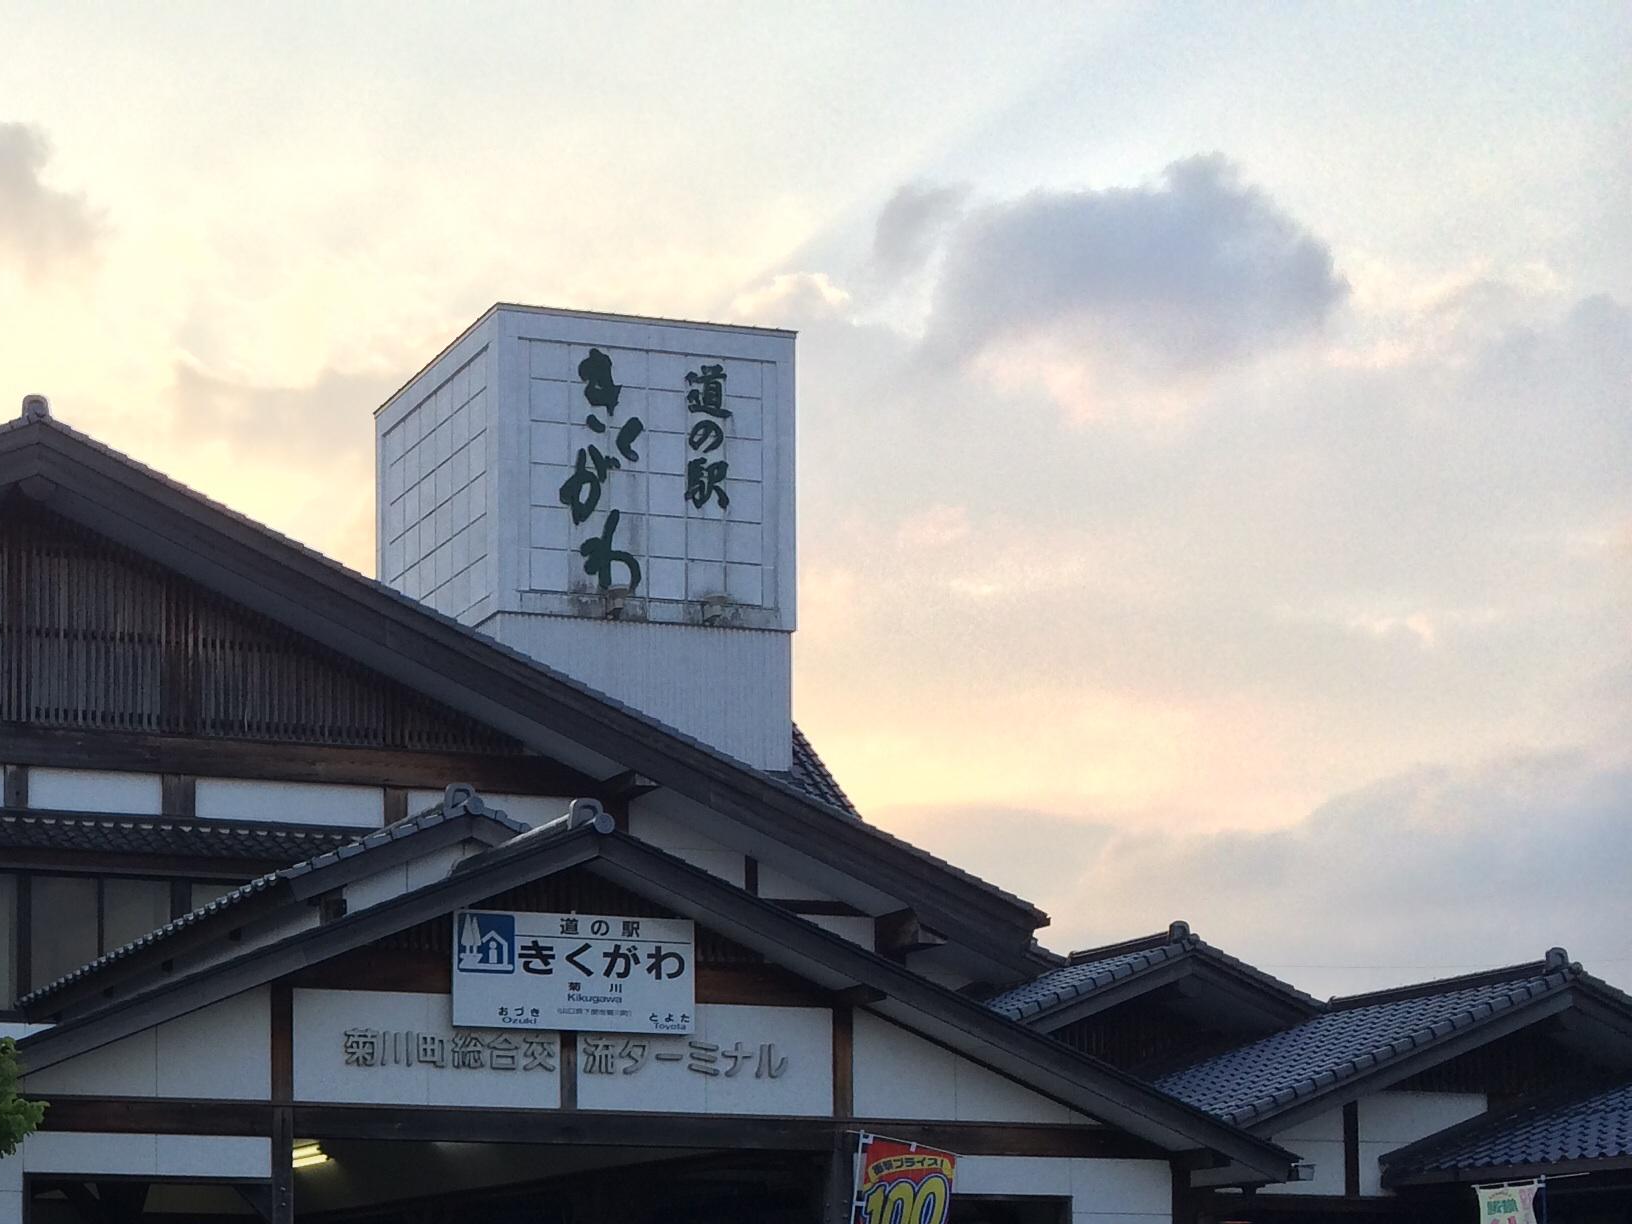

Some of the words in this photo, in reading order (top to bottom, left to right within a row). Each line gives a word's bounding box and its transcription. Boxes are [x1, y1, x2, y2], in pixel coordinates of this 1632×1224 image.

[684, 364, 732, 509] 道の駅
[559, 348, 645, 593] きくがわ
[559, 918, 641, 938] 道の駅
[518, 940, 686, 980] きくがわ
[567, 993, 623, 1004] Kikugawa
[498, 1006, 540, 1017] おづき
[501, 1016, 537, 1025] Ozuki
[649, 1012, 691, 1024] とよた
[653, 1022, 687, 1031] Toyota
